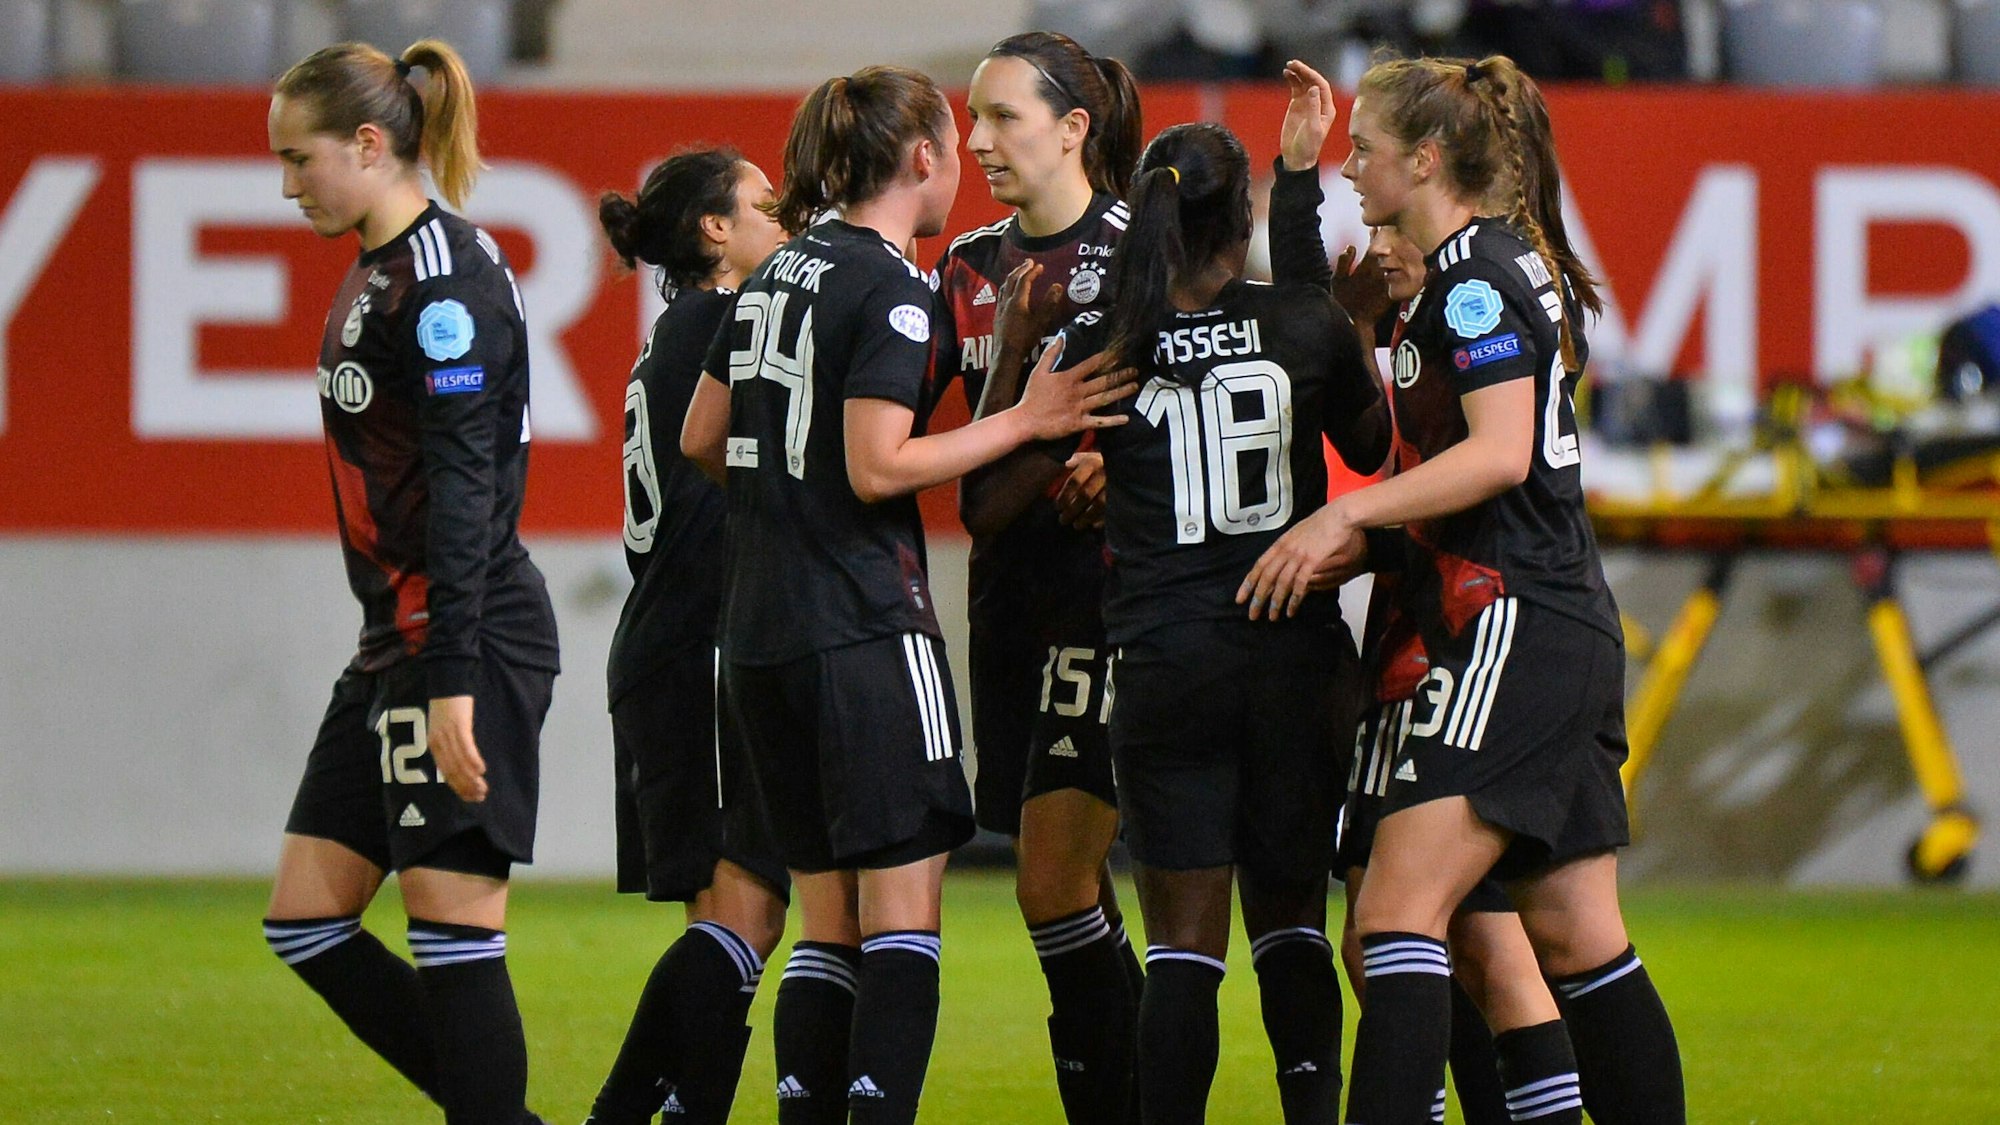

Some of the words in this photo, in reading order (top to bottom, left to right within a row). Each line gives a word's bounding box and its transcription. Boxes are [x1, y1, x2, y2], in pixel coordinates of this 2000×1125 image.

[762, 250, 836, 294] POLLAK
[1078, 243, 1116, 258] Dnk
[1469, 338, 1519, 361] RESPECT
[434, 371, 484, 388] RESPECT
[725, 291, 814, 480] 24
[1135, 360, 1293, 544] 18
[1040, 646, 1095, 717] 15
[375, 706, 428, 784] 12
